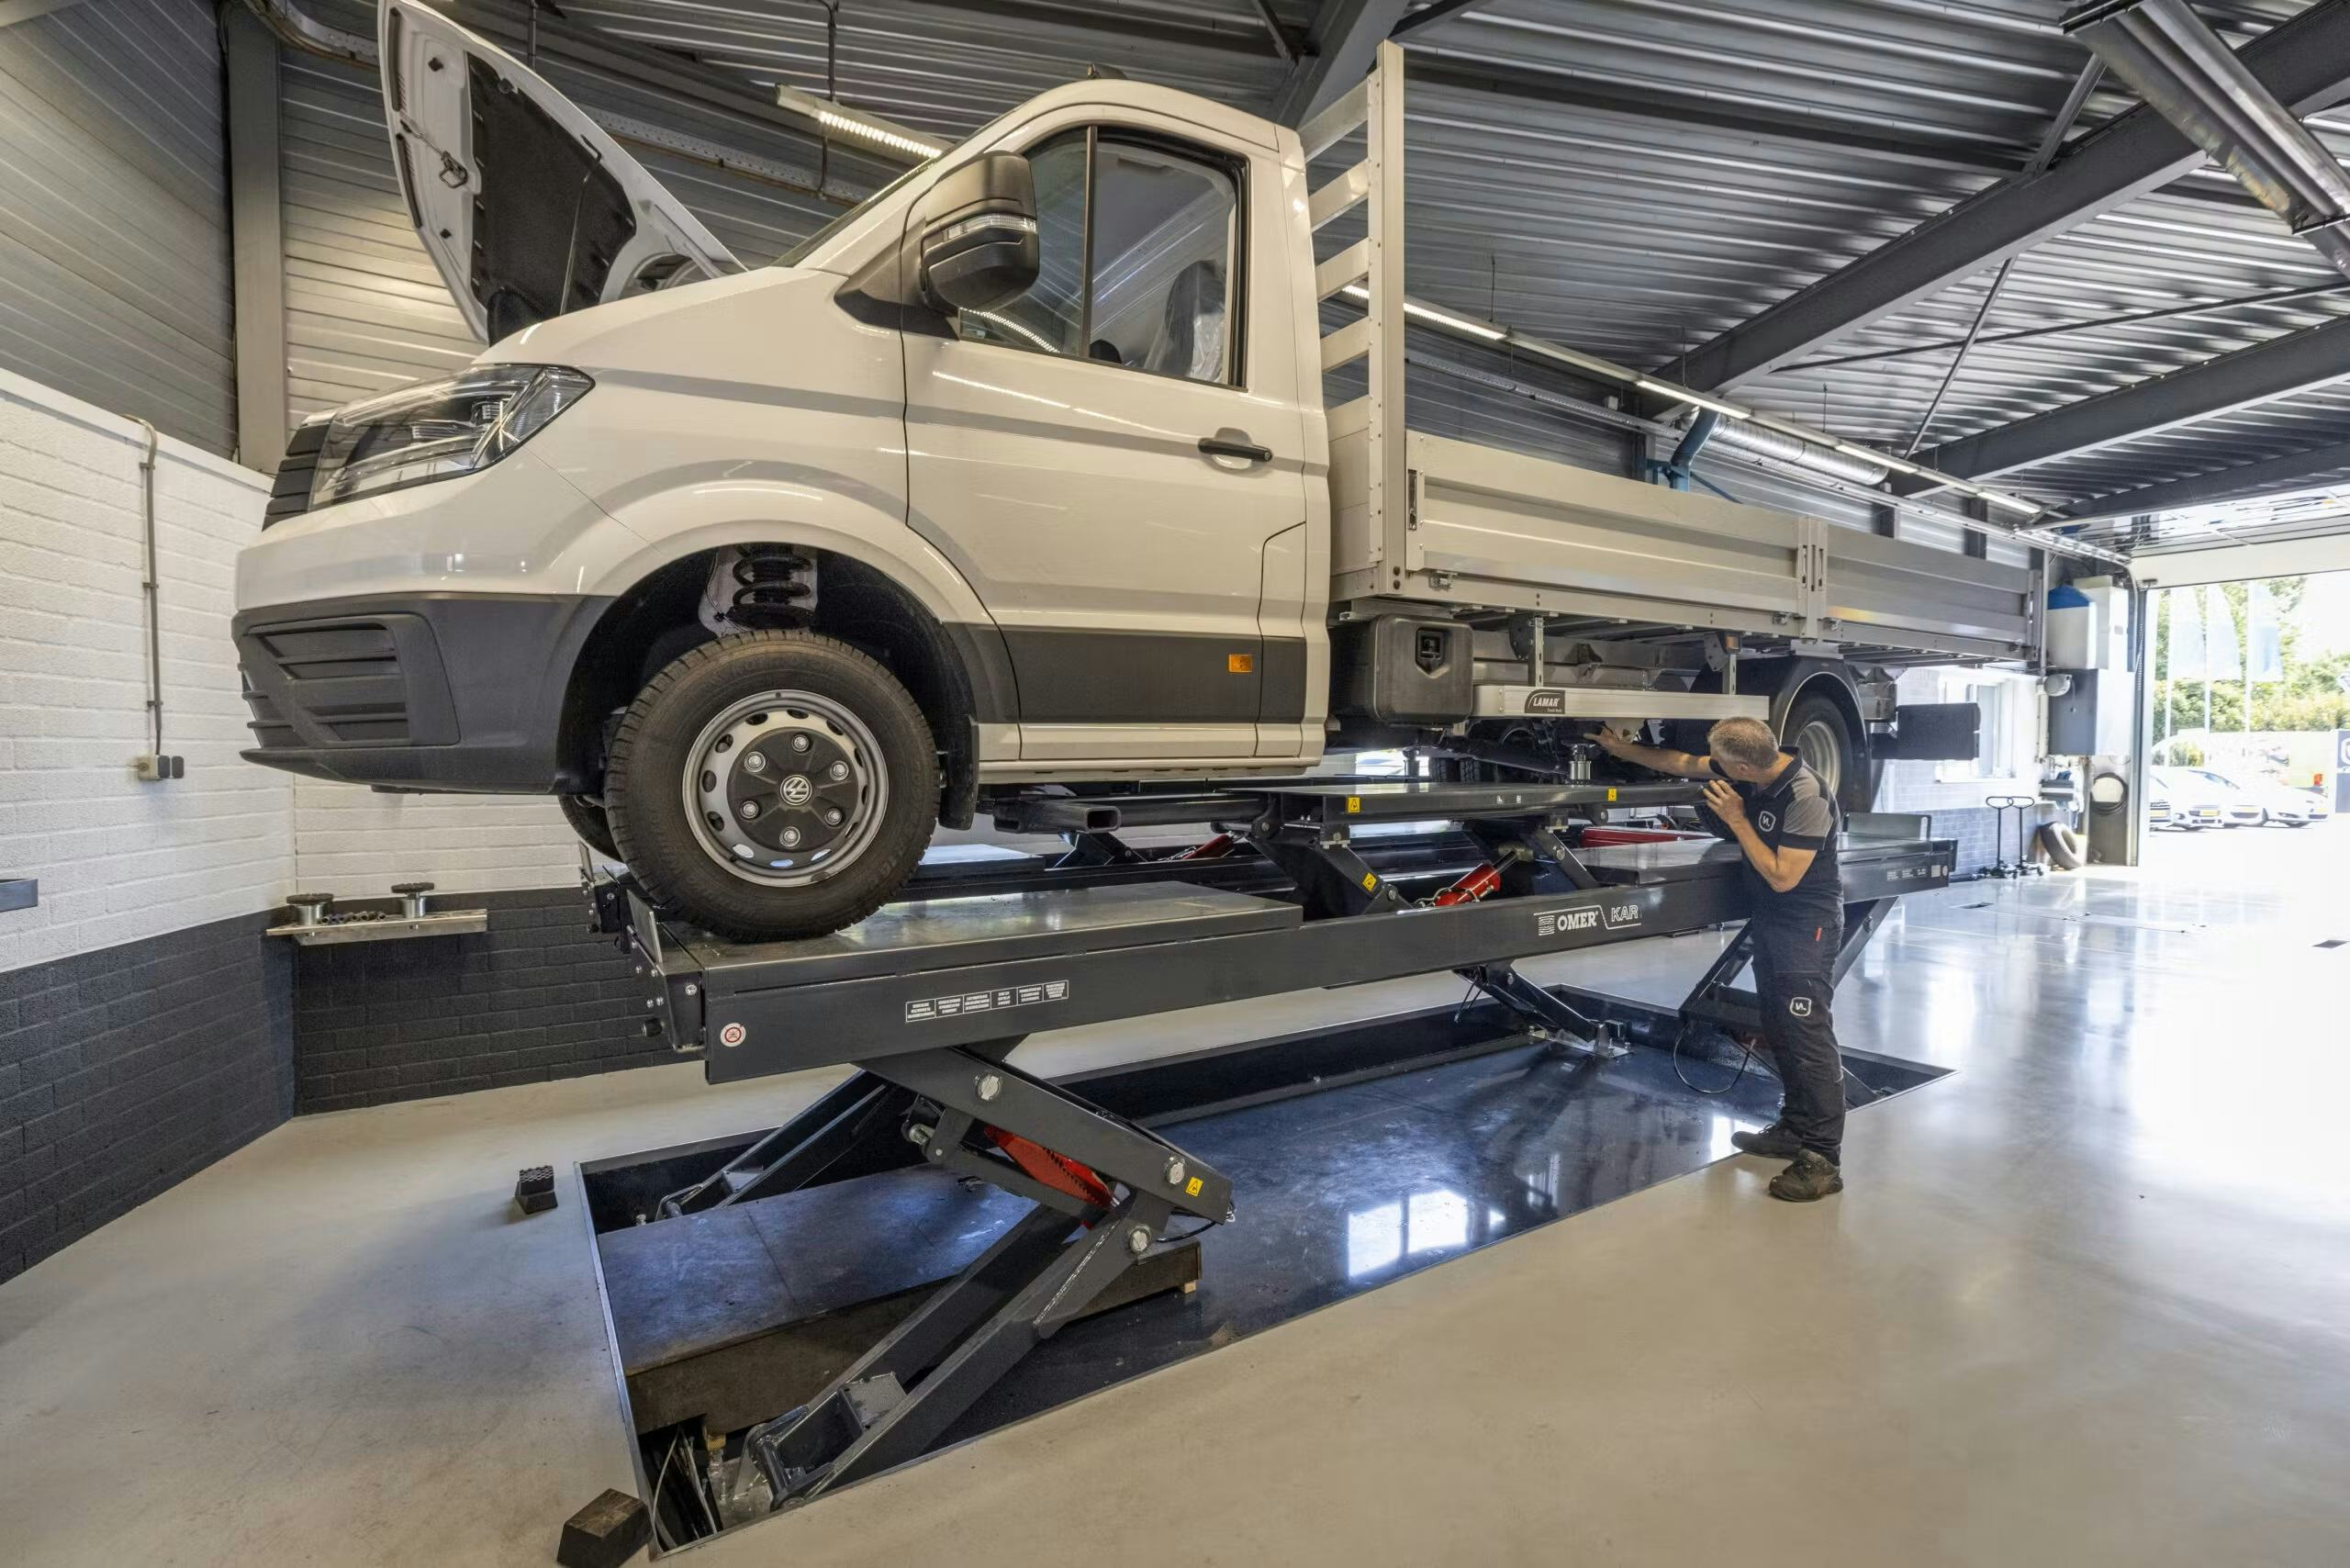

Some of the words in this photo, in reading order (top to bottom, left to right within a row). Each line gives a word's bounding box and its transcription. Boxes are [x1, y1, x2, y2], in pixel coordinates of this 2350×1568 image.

[1533, 697, 1559, 707] LAMAR
[1558, 912, 1597, 931] OMER
[1611, 905, 1639, 923] KAR
